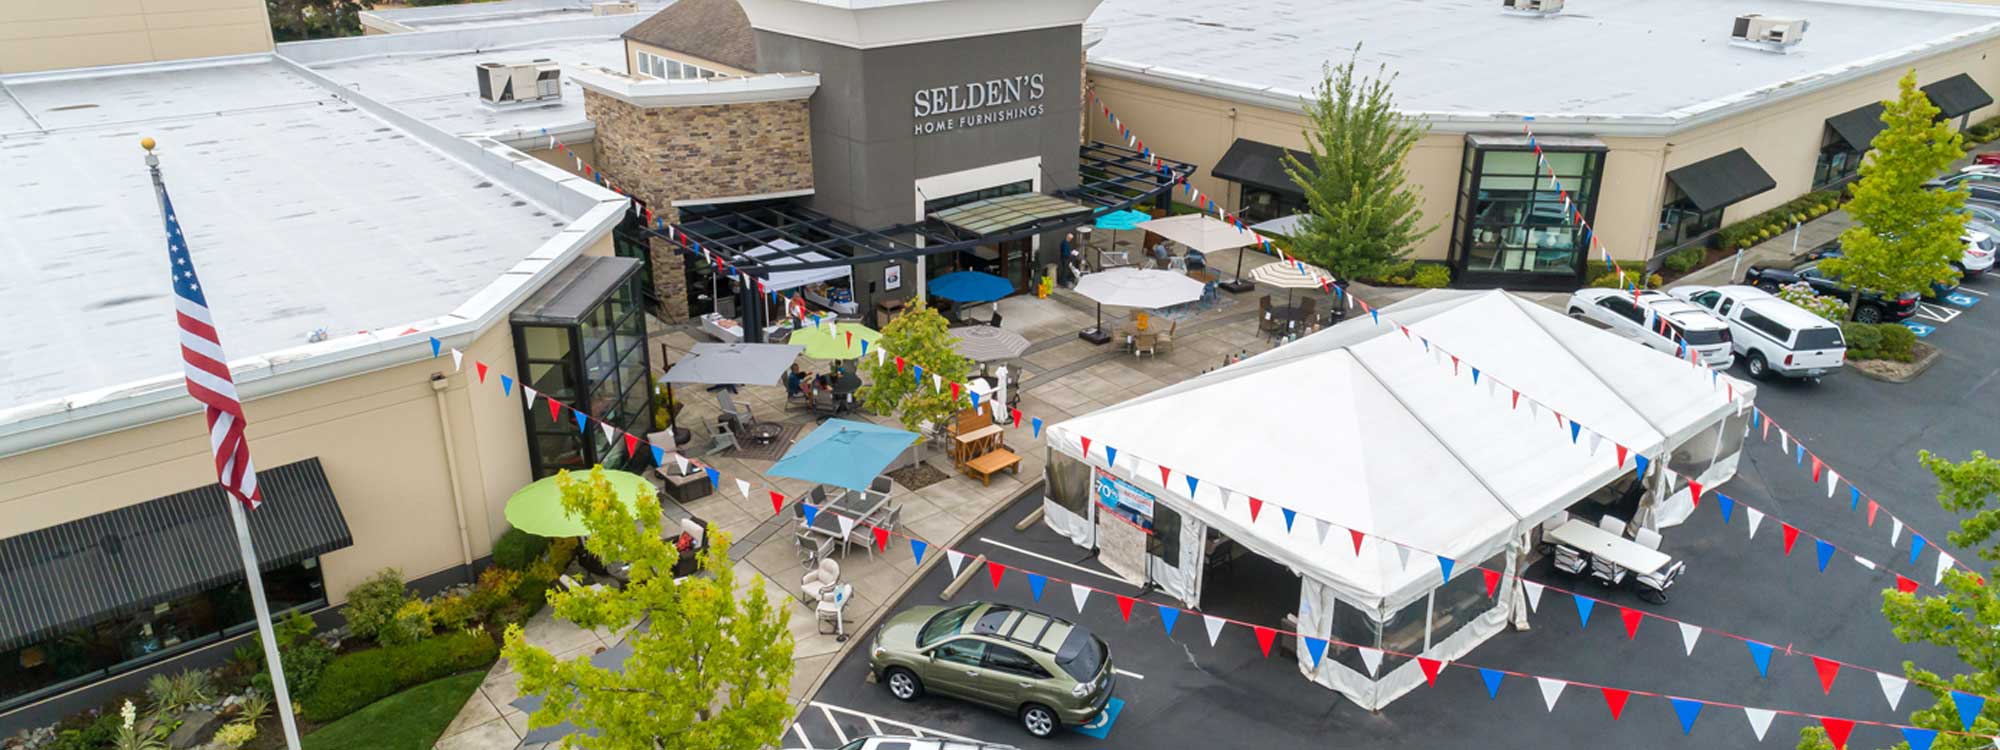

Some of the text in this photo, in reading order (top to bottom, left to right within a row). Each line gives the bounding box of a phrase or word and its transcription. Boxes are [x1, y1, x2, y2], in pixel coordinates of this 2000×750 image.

[914, 73, 1045, 118] SELDEN'S
[914, 104, 1045, 136] HOME FURNISHINGS
